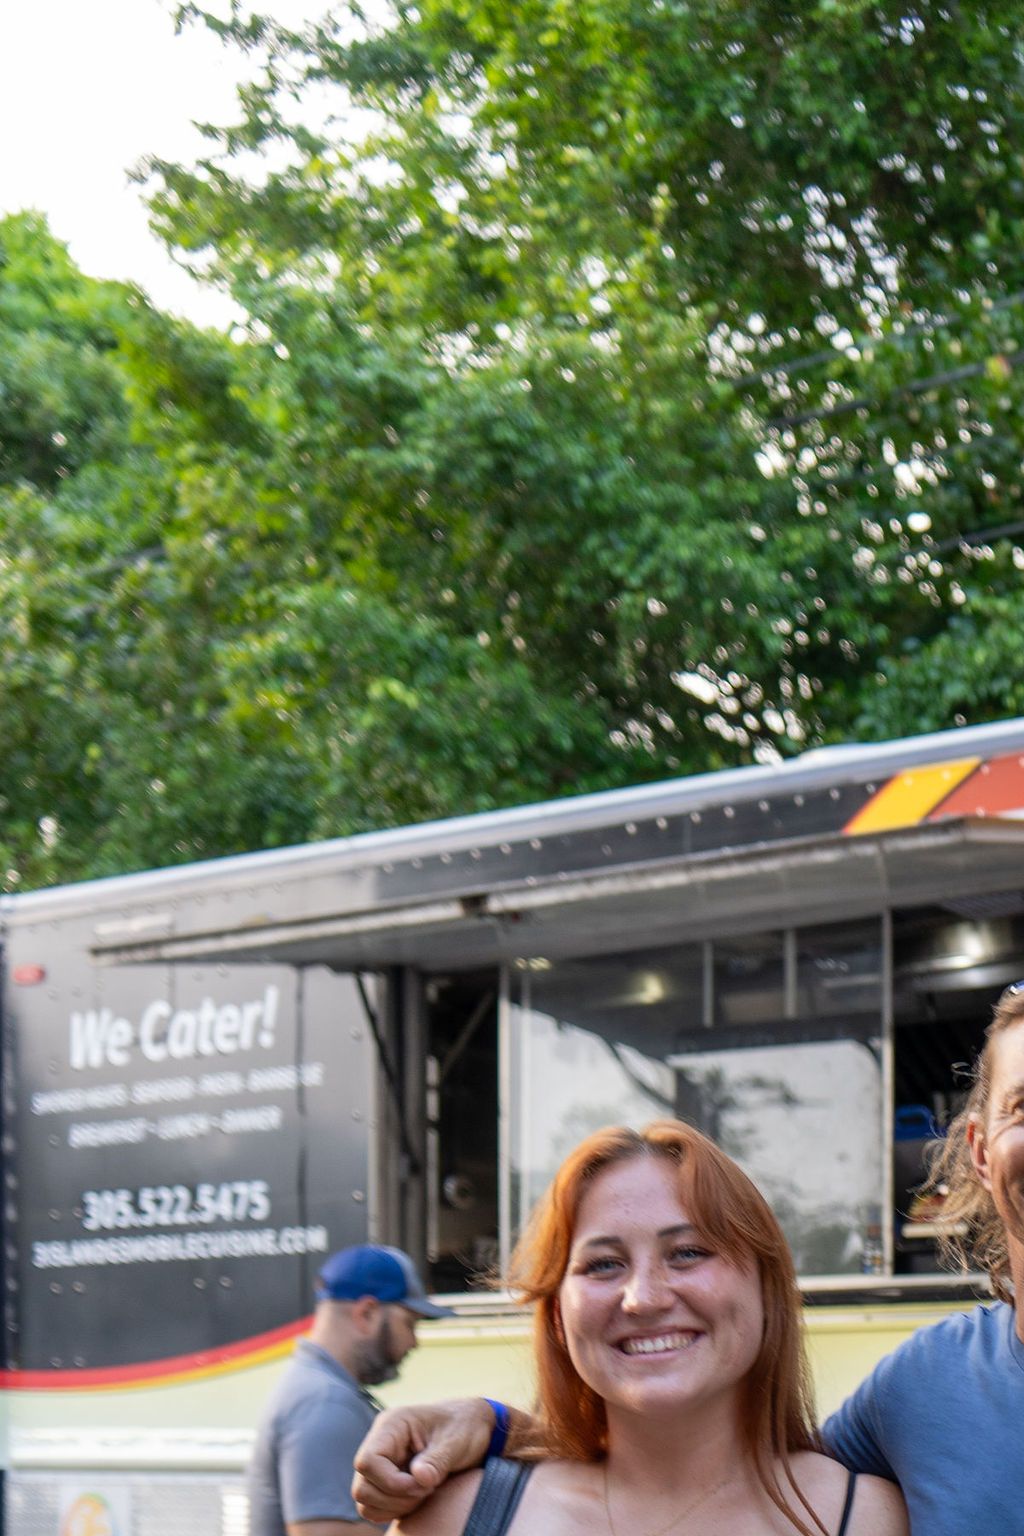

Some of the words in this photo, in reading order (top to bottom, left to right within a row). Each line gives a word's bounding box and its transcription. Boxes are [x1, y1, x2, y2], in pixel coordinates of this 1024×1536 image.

[70, 1009, 133, 1070] We
[140, 985, 279, 1062] Cater!
[82, 1179, 270, 1231] 305.522.5475
